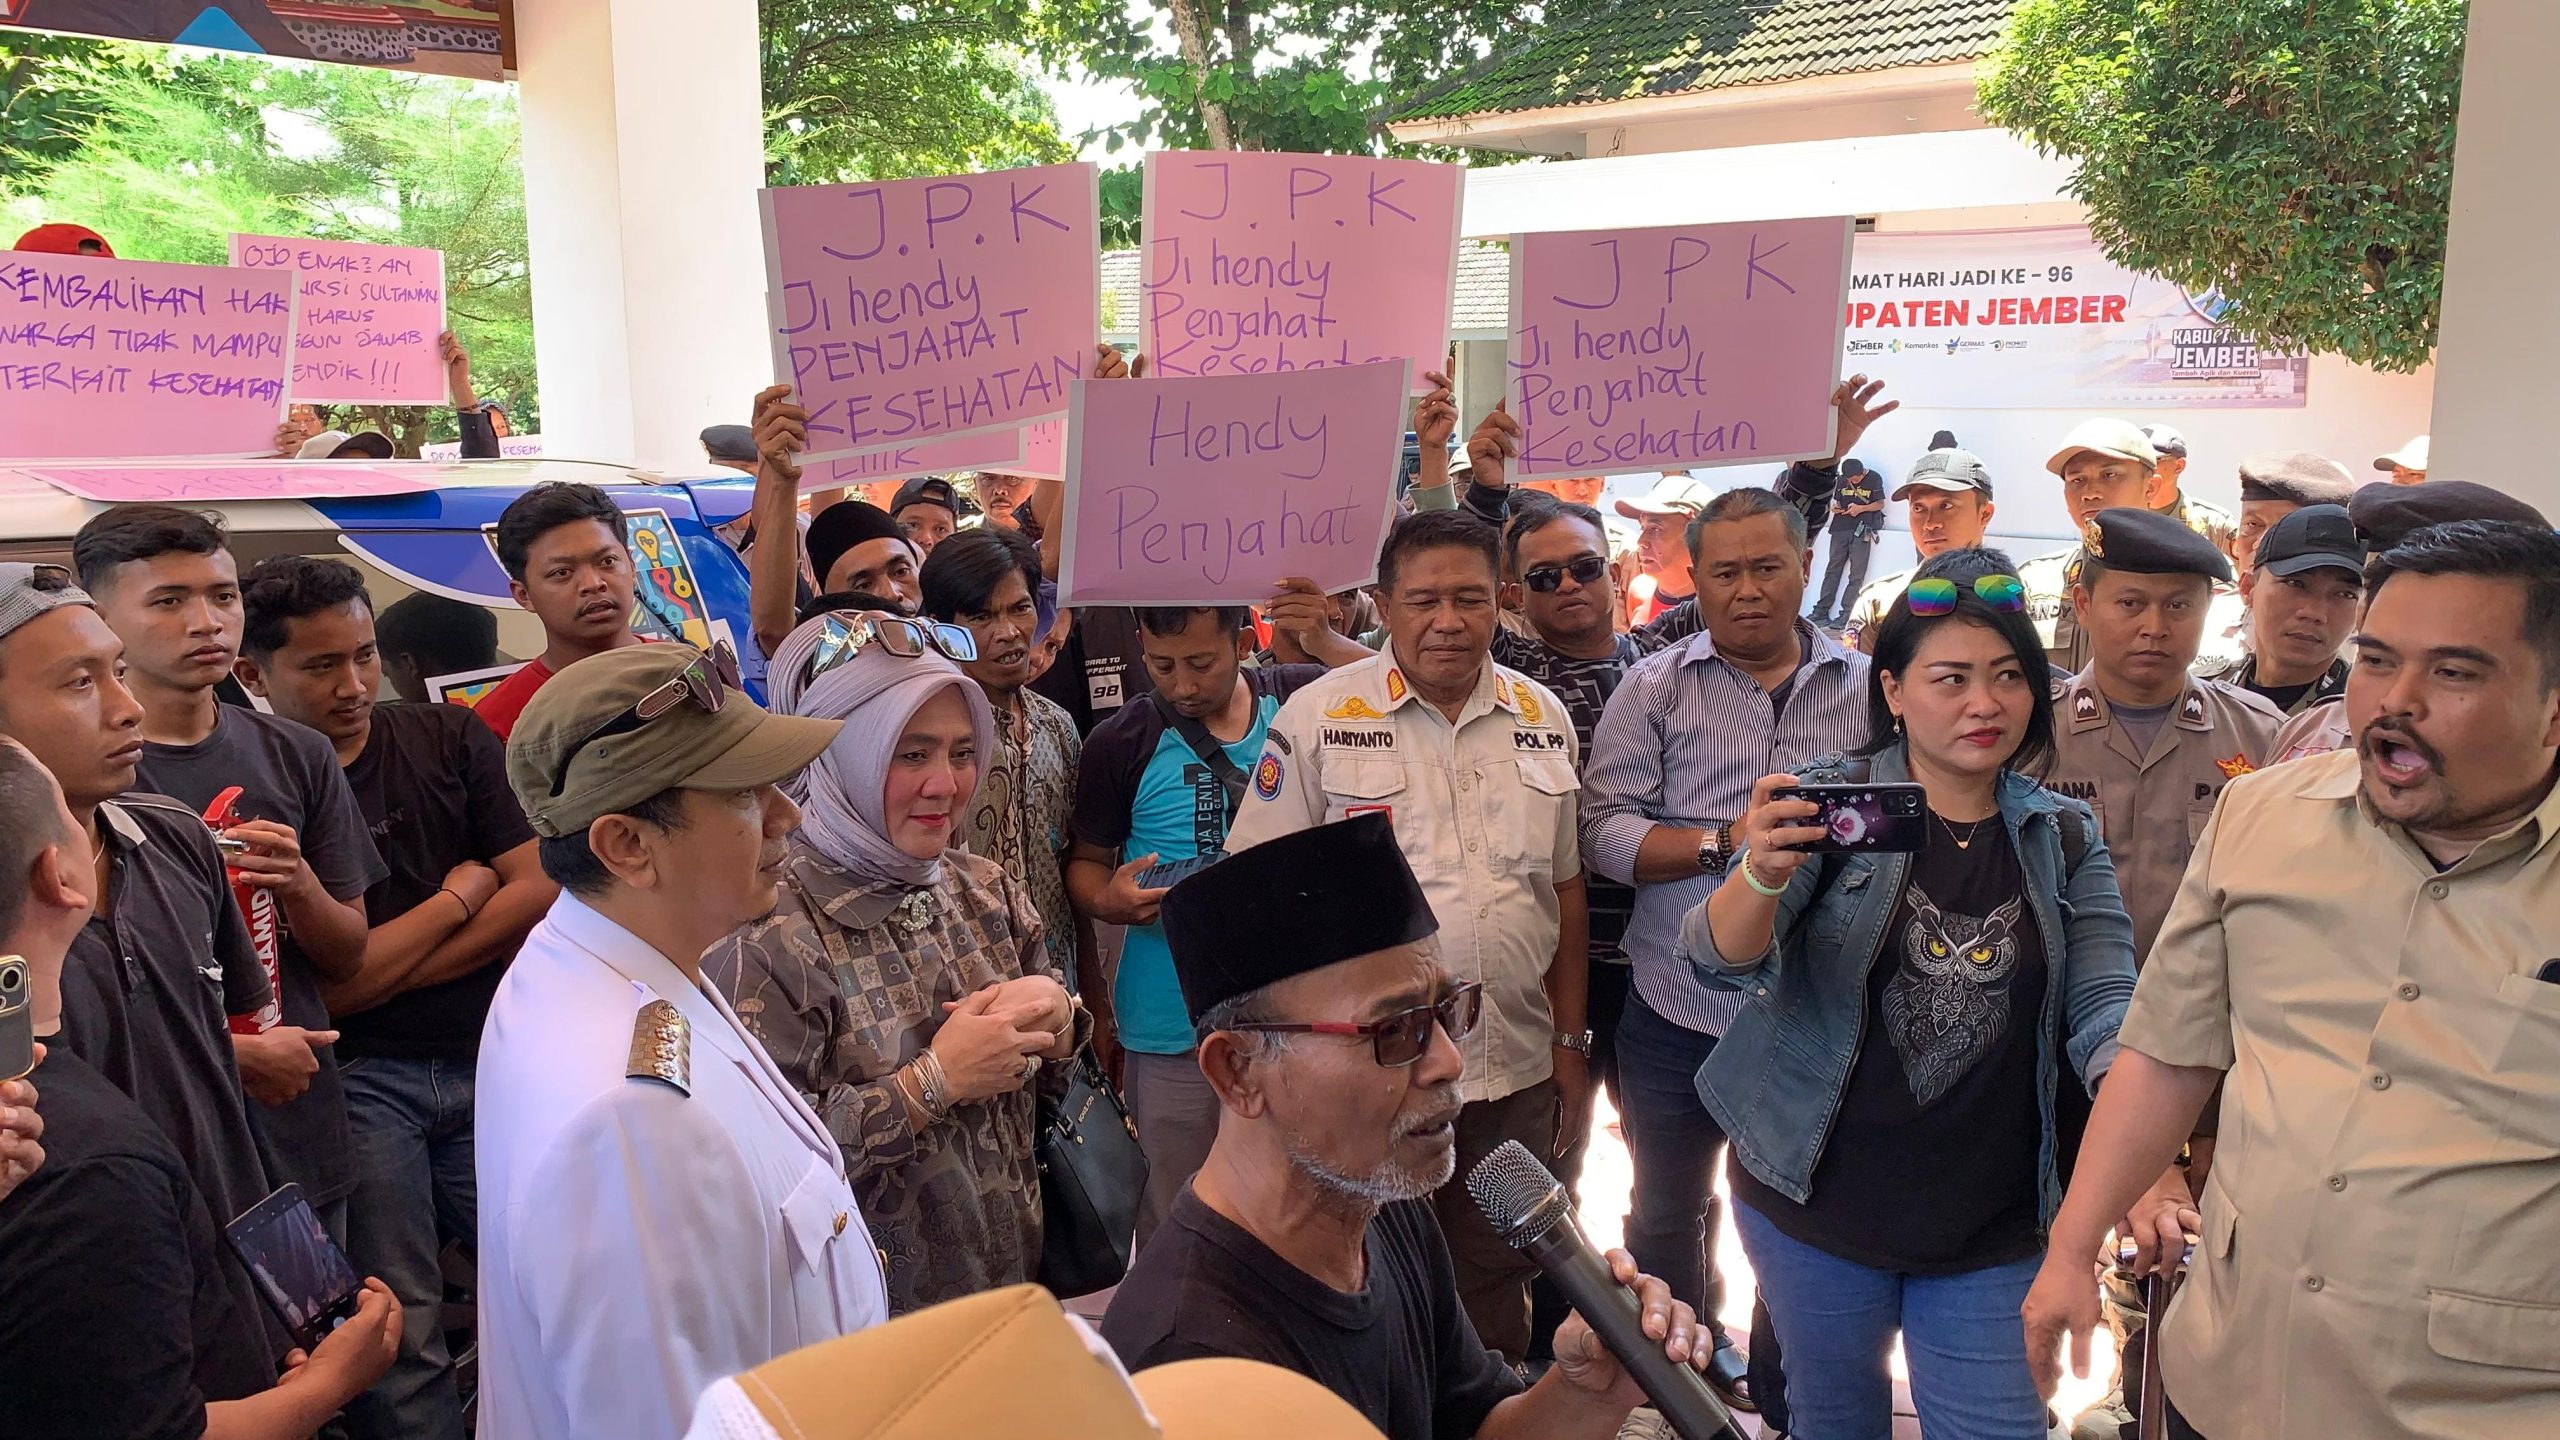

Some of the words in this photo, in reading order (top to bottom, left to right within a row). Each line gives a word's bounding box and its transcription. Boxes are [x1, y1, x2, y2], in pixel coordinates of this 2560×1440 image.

[1849, 273, 1894, 290] MAT
[1899, 271, 1945, 288] HARI
[1949, 269, 1996, 287] JADI
[2001, 268, 2026, 285] KE
[2047, 265, 2073, 282] 96
[224, 288, 289, 315] HAK
[1976, 294, 2126, 326] JEMBER
[307, 308, 375, 326] HARUS
[107, 329, 179, 353] TIDAK
[192, 332, 282, 359] MAMPU
[787, 307, 1029, 396] PENJAHAT
[2171, 345, 2260, 369] JEMBER
[148, 368, 285, 408] KESEHATAN
[801, 350, 1082, 450] KESEHATAN
[1148, 394, 1328, 480] Hendy
[1092, 684, 1120, 698] 98
[1323, 728, 1394, 748] HARIYANTO
[1513, 731, 1544, 749] POL
[1547, 733, 1565, 750] PP
[1197, 772, 1214, 821] DENIM
